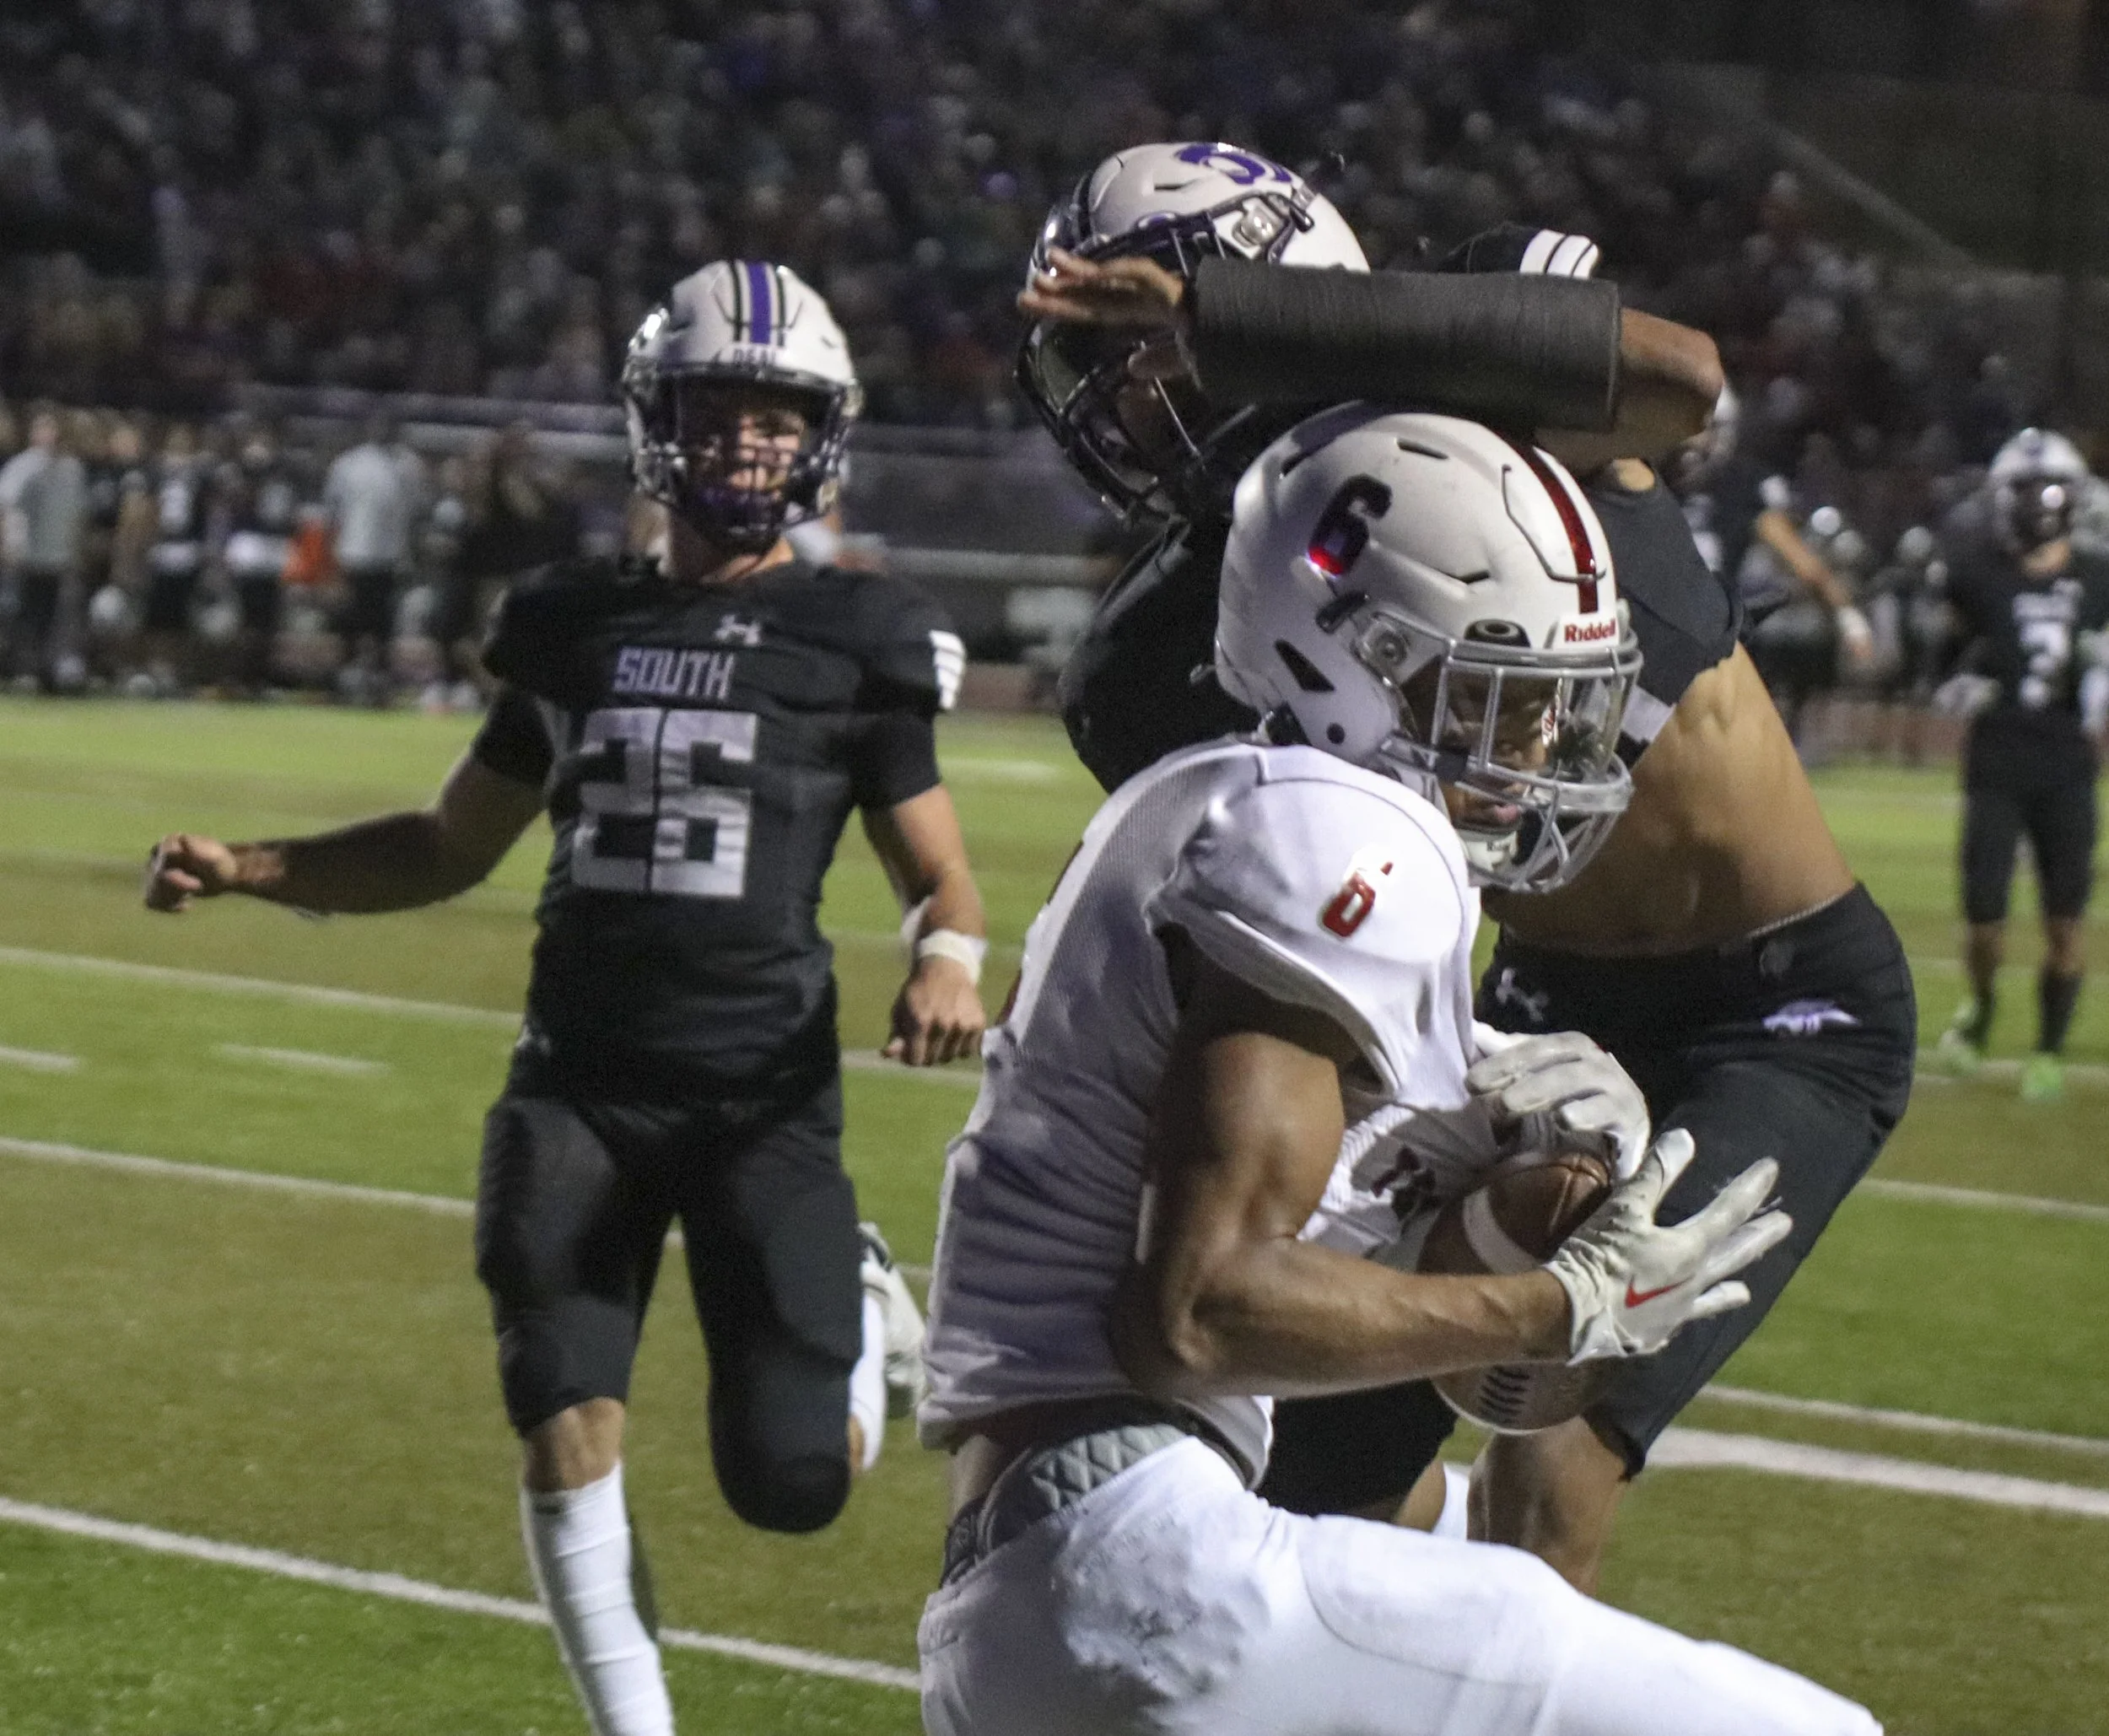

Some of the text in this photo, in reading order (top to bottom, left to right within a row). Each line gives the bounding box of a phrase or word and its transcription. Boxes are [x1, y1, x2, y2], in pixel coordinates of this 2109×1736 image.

[1308, 473, 1393, 575] 6
[1564, 617, 1616, 643] Riddell
[612, 647, 735, 699] SOUTH
[571, 708, 757, 897] 26
